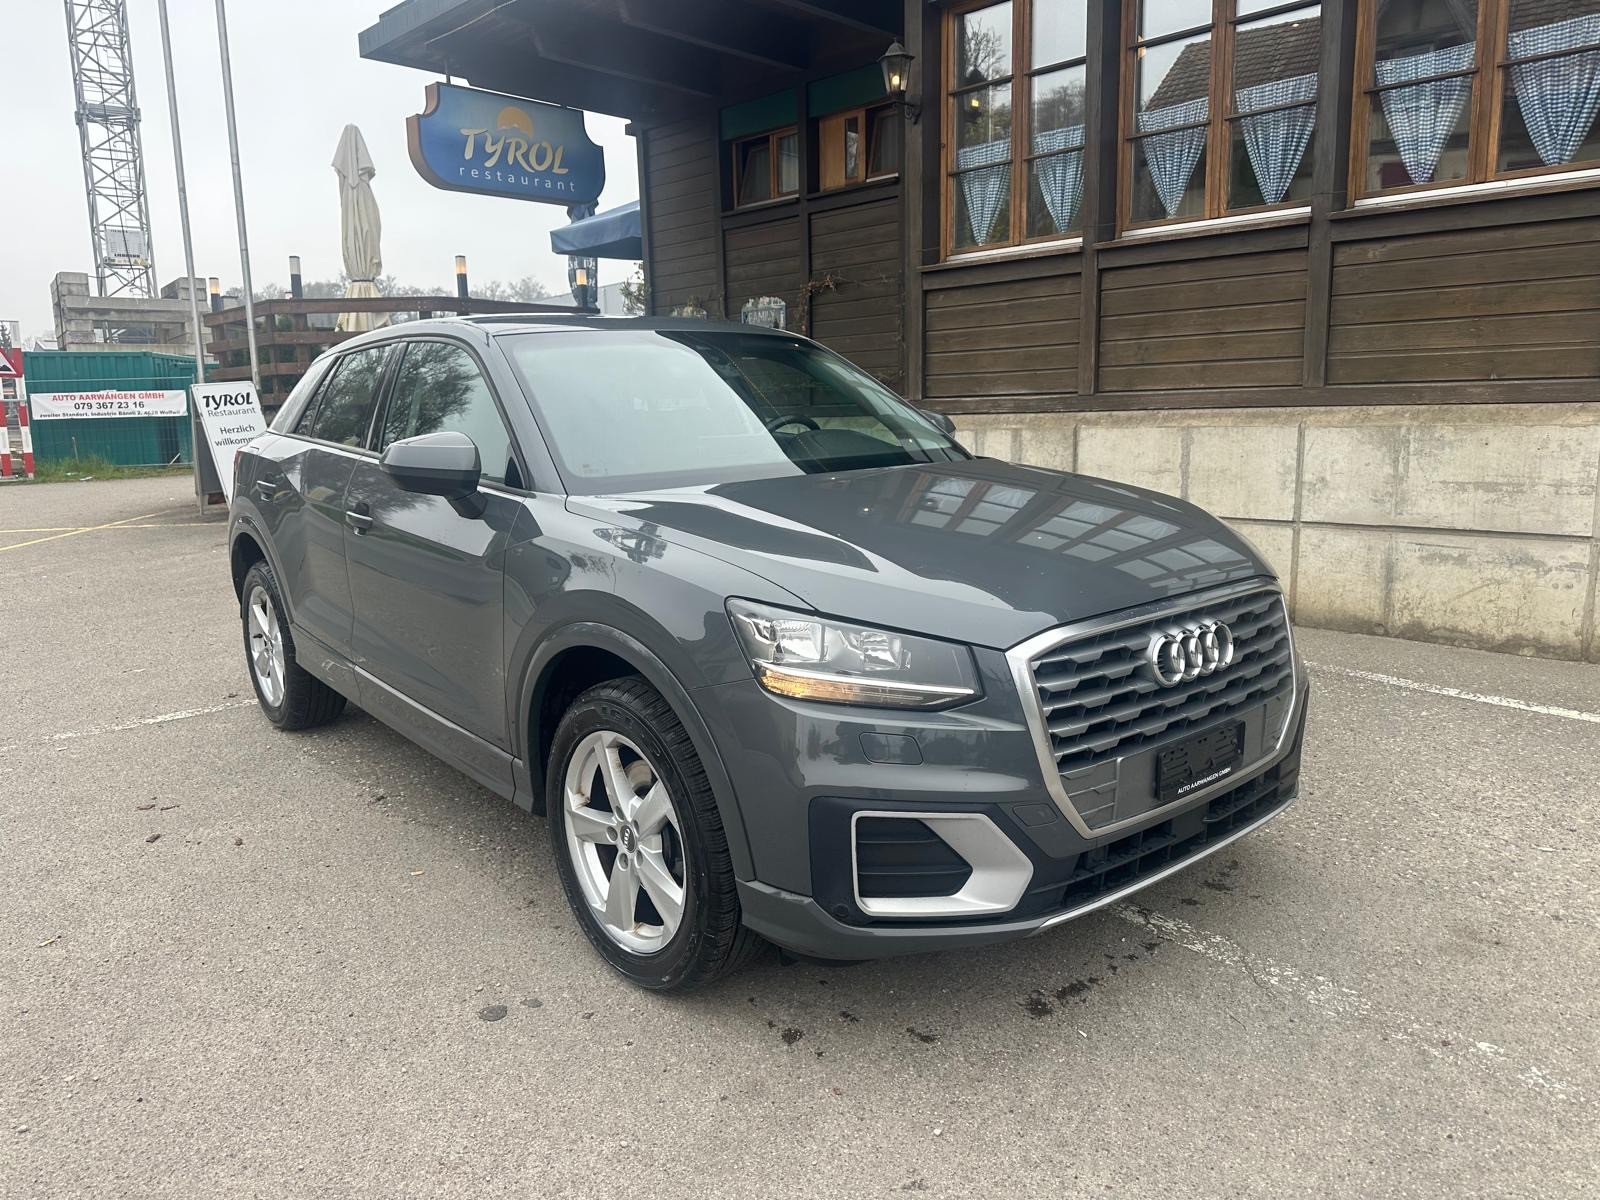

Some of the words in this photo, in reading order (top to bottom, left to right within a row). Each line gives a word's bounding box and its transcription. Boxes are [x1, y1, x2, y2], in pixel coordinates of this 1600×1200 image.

[460, 128, 569, 175] TYROL
[459, 166, 575, 192] restaurant
[74, 402, 93, 410] 079
[117, 401, 129, 409] 23
[202, 392, 253, 410] TYROL
[207, 407, 256, 417] Restaurant
[219, 424, 256, 435] Herzlich
[1177, 784, 1191, 794] AUTO
